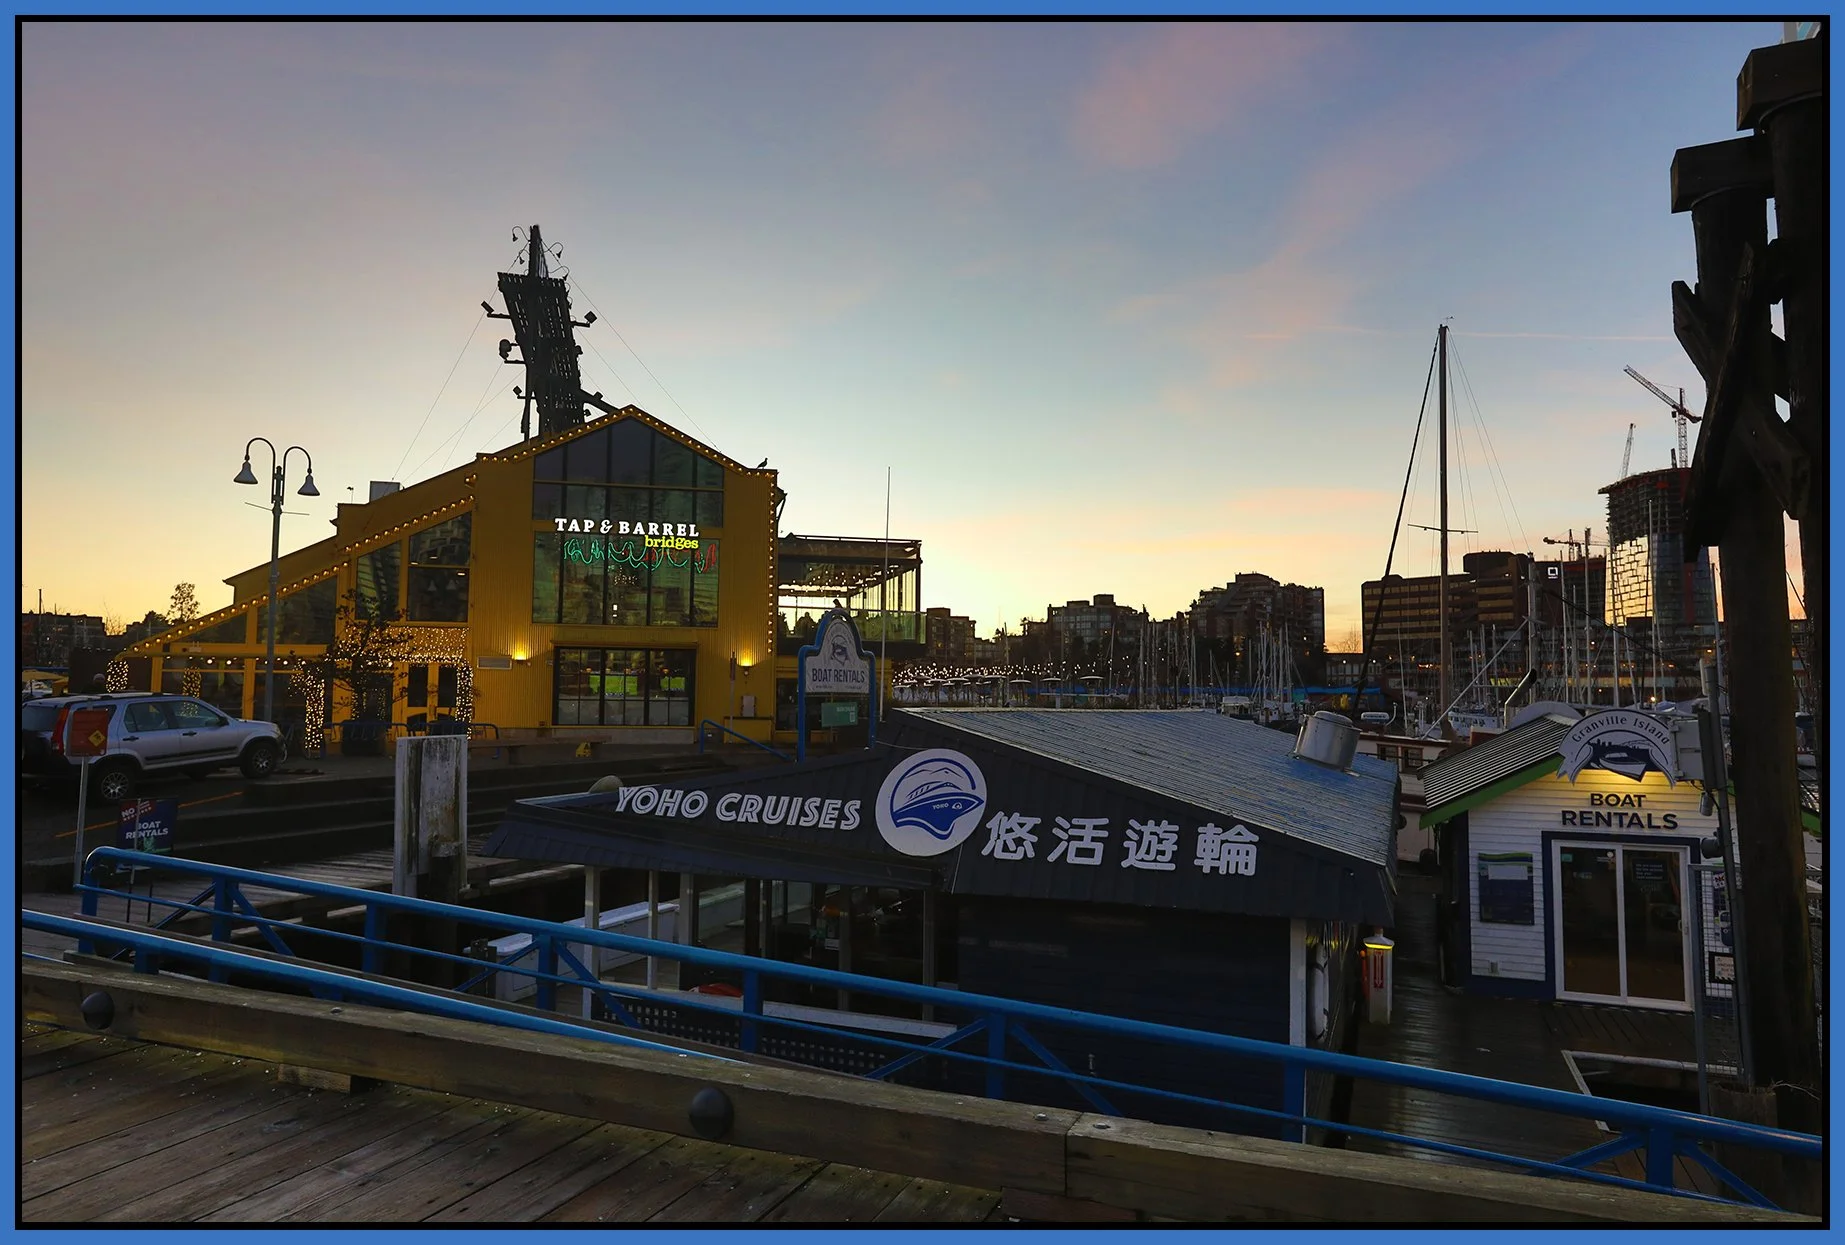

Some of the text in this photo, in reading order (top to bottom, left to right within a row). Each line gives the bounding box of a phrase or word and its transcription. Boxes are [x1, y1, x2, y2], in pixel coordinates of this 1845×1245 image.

[554, 518, 699, 537] TAP & BARREL
[644, 535, 699, 549] bridges
[812, 668, 865, 683] BOAT RENTALS
[1572, 716, 1670, 744] Granville Island
[615, 786, 862, 831] YOHO CRUISES
[1590, 793, 1646, 807] BOAT
[121, 807, 135, 818] NO
[1561, 810, 1678, 829] RENTALS
[981, 810, 1260, 877] 悠活遊輪
